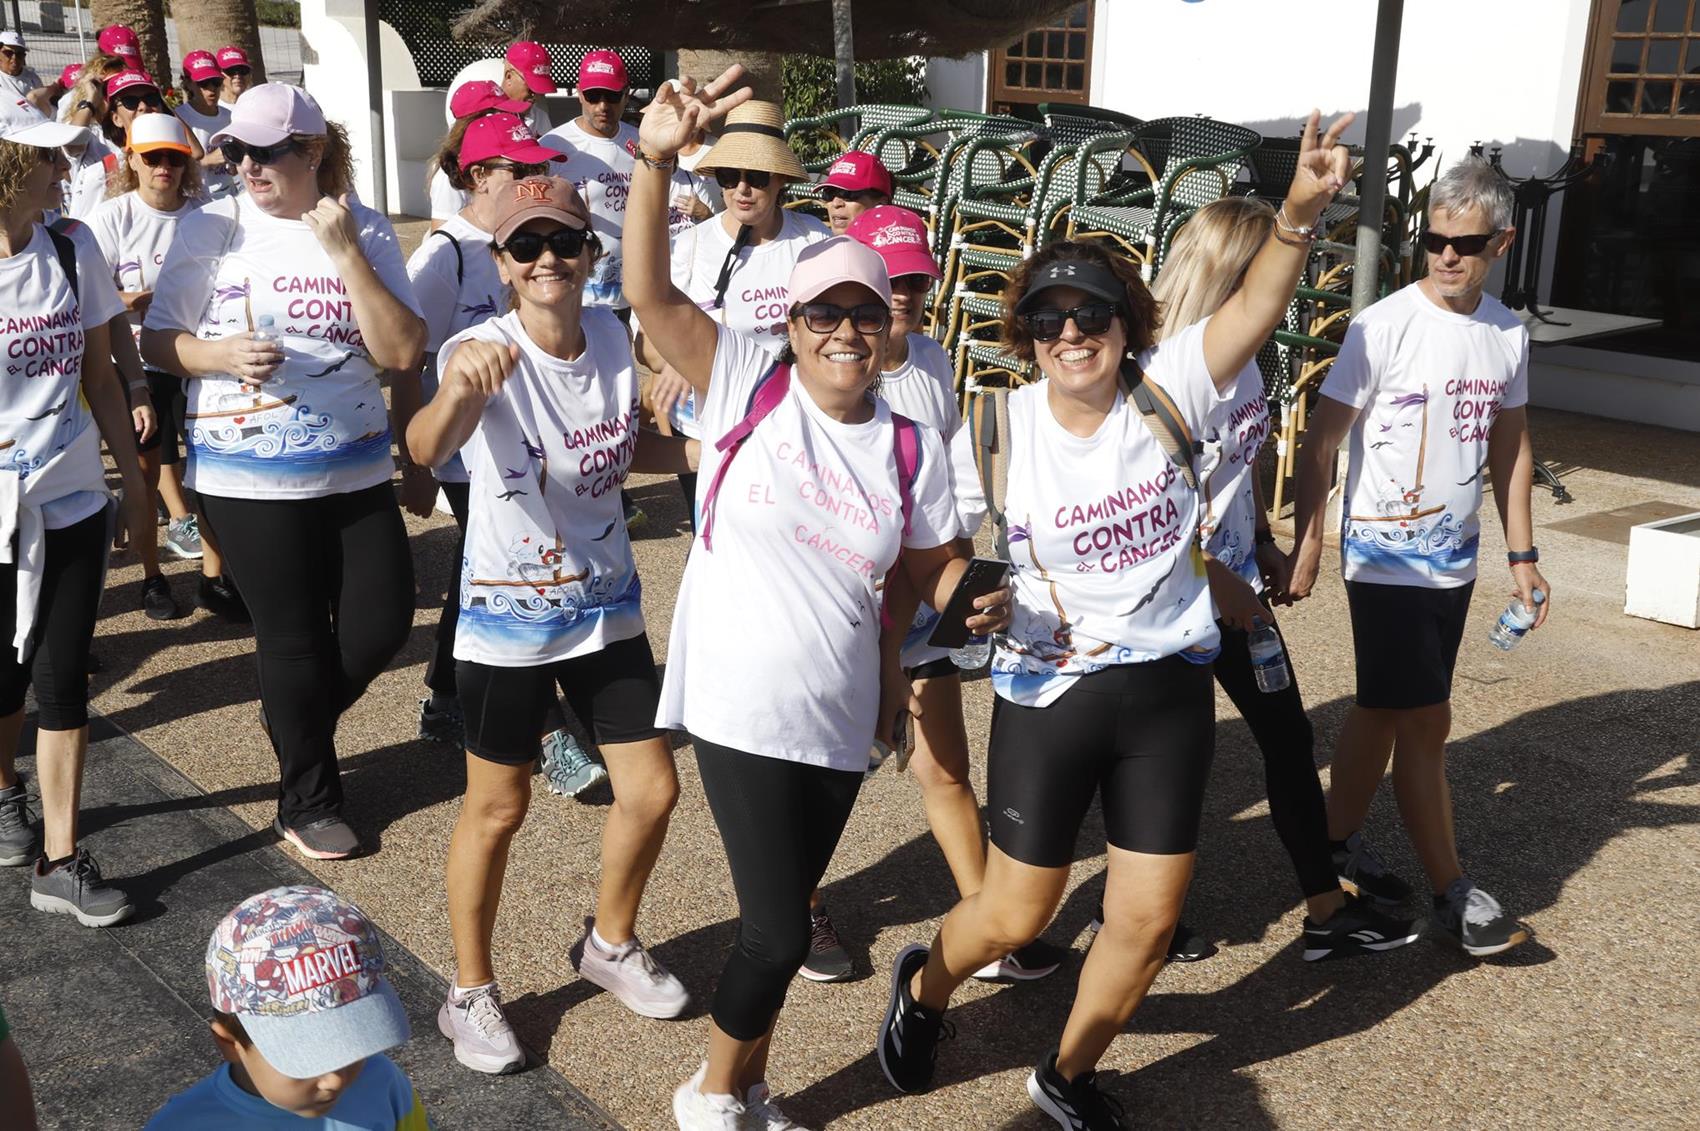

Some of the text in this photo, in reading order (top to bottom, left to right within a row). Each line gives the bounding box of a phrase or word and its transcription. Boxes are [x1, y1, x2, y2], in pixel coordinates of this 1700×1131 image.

[515, 182, 553, 202] NY
[605, 185, 629, 197] CON
[273, 276, 347, 295] CAMIN
[288, 299, 352, 322] CONT
[575, 483, 590, 497] EL
[1055, 460, 1177, 529] CAMINAMOS
[748, 480, 880, 536] EL CONTRA
[1073, 497, 1179, 556] CONTRA
[283, 943, 361, 994] MARVEL
